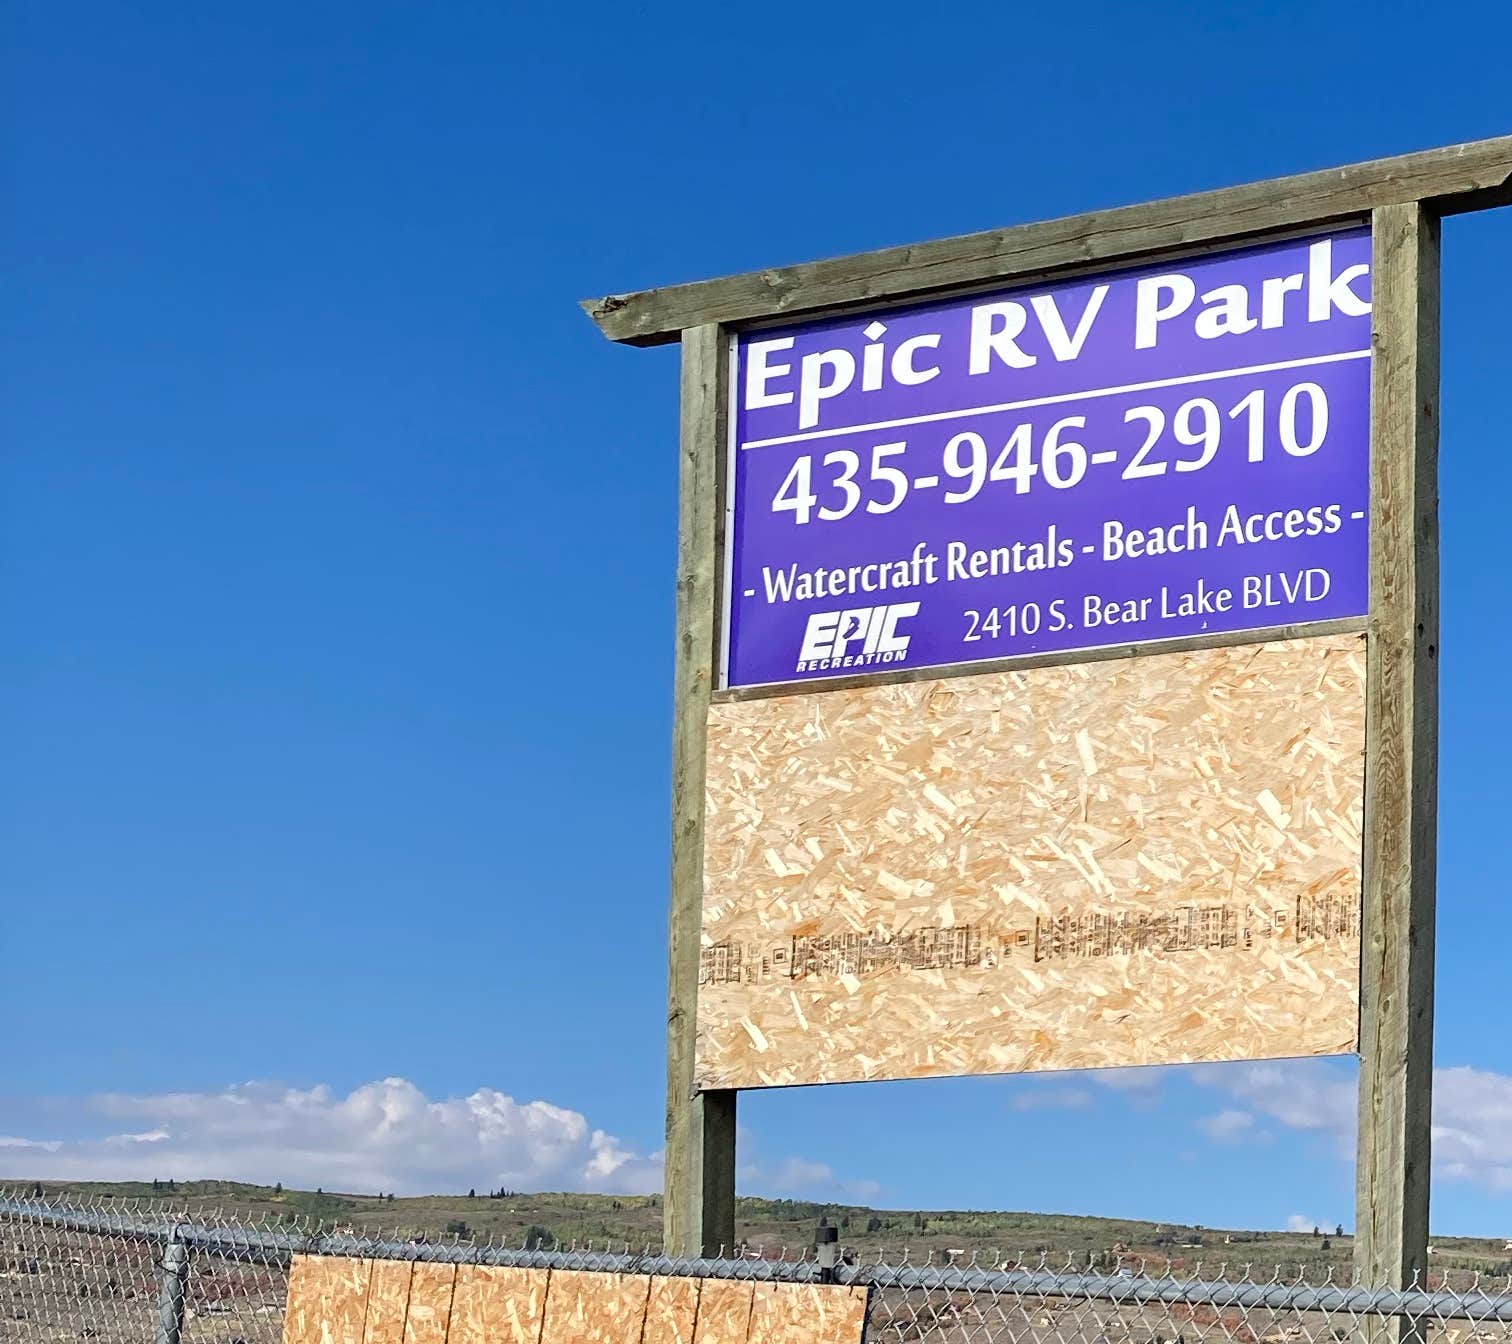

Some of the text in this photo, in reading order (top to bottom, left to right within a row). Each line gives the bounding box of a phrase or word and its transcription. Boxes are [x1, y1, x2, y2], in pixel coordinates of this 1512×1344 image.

[745, 238, 1373, 430] Epic RV Park
[771, 382, 1329, 525] 435-946-2910
[762, 542, 939, 604] Watercraft
[946, 524, 1074, 582] Rentals
[1103, 505, 1208, 561] Beach
[1216, 504, 1342, 548] Access
[798, 601, 921, 662] EPIC
[963, 568, 1331, 642] 2410 S. Bear Lake BLVD
[796, 649, 908, 673] RECREATION
